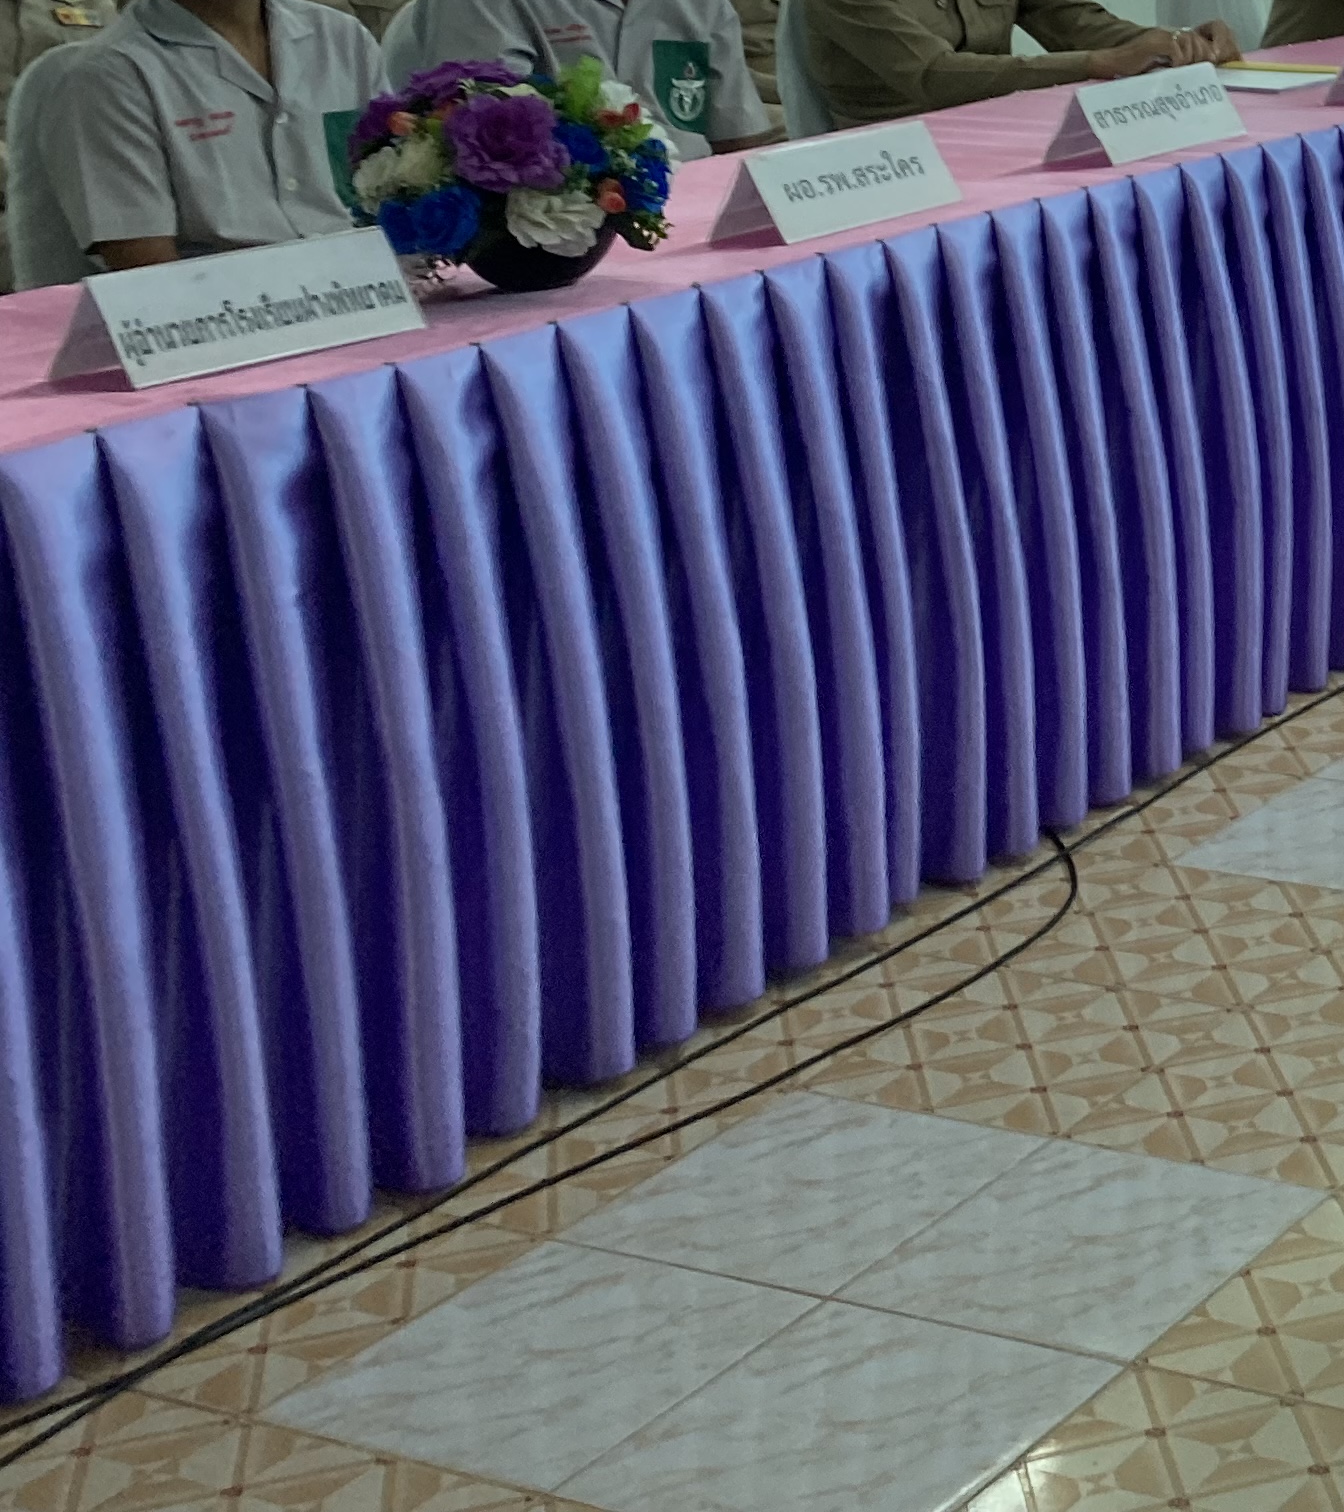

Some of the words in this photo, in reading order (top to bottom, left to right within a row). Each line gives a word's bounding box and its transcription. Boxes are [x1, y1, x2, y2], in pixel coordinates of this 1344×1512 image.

[1092, 83, 1224, 130] สาธารณสุขอำเภอ
[782, 150, 926, 203] ผอ.รพ.สระใคร
